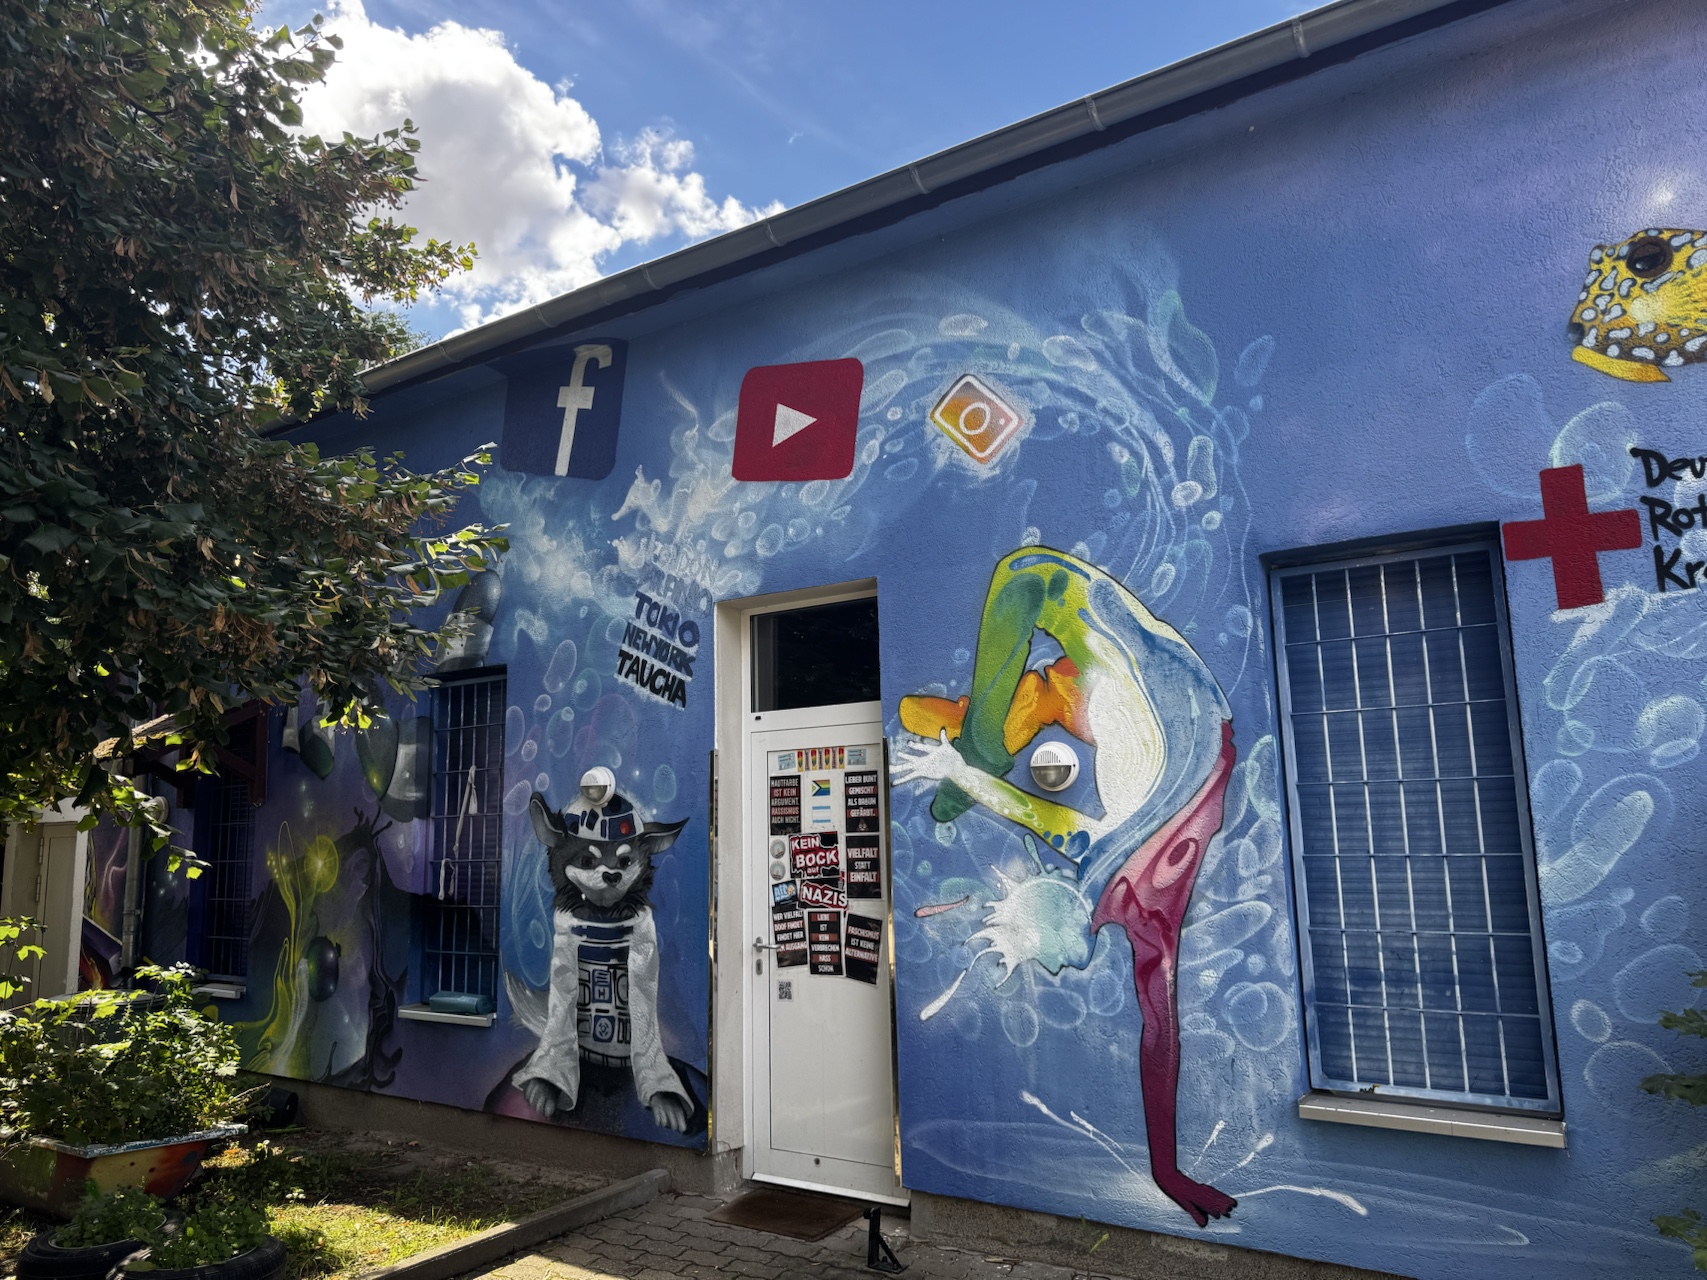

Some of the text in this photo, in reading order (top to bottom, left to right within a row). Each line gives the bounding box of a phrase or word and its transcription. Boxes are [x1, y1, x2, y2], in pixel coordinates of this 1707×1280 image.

[556, 344, 613, 477] f
[1653, 544, 1707, 592] Kr
[635, 590, 700, 648] TOKIO
[617, 648, 687, 709] TAUCHA
[771, 779, 799, 787] HAUTFARBE
[845, 774, 877, 784] LIEBER BUNT
[774, 788, 797, 797] IST KEIN
[848, 785, 874, 795] GEMISCHT
[847, 796, 877, 806] ALS BRAUN
[771, 806, 799, 816] RASSISMUS
[771, 816, 784, 824] AUCH
[791, 837, 820, 850] KEIN
[847, 847, 878, 858] VIELFALT
[796, 850, 838, 868] BOCK
[807, 866, 819, 874] auf
[854, 861, 871, 870] STATT
[850, 871, 877, 883] EINFALT
[802, 886, 848, 907] NAZIS
[773, 912, 783, 920] WER
[817, 913, 830, 921] LIEBE
[787, 920, 803, 930] FINDET
[819, 923, 828, 932] IST
[777, 931, 804, 942] FINDET HIER
[847, 925, 880, 940] FASCHISMUS
[818, 934, 830, 942] KEIN
[811, 943, 840, 952] VERBRECHEN
[850, 937, 875, 950] IST KEINE
[818, 954, 832, 963] HASS
